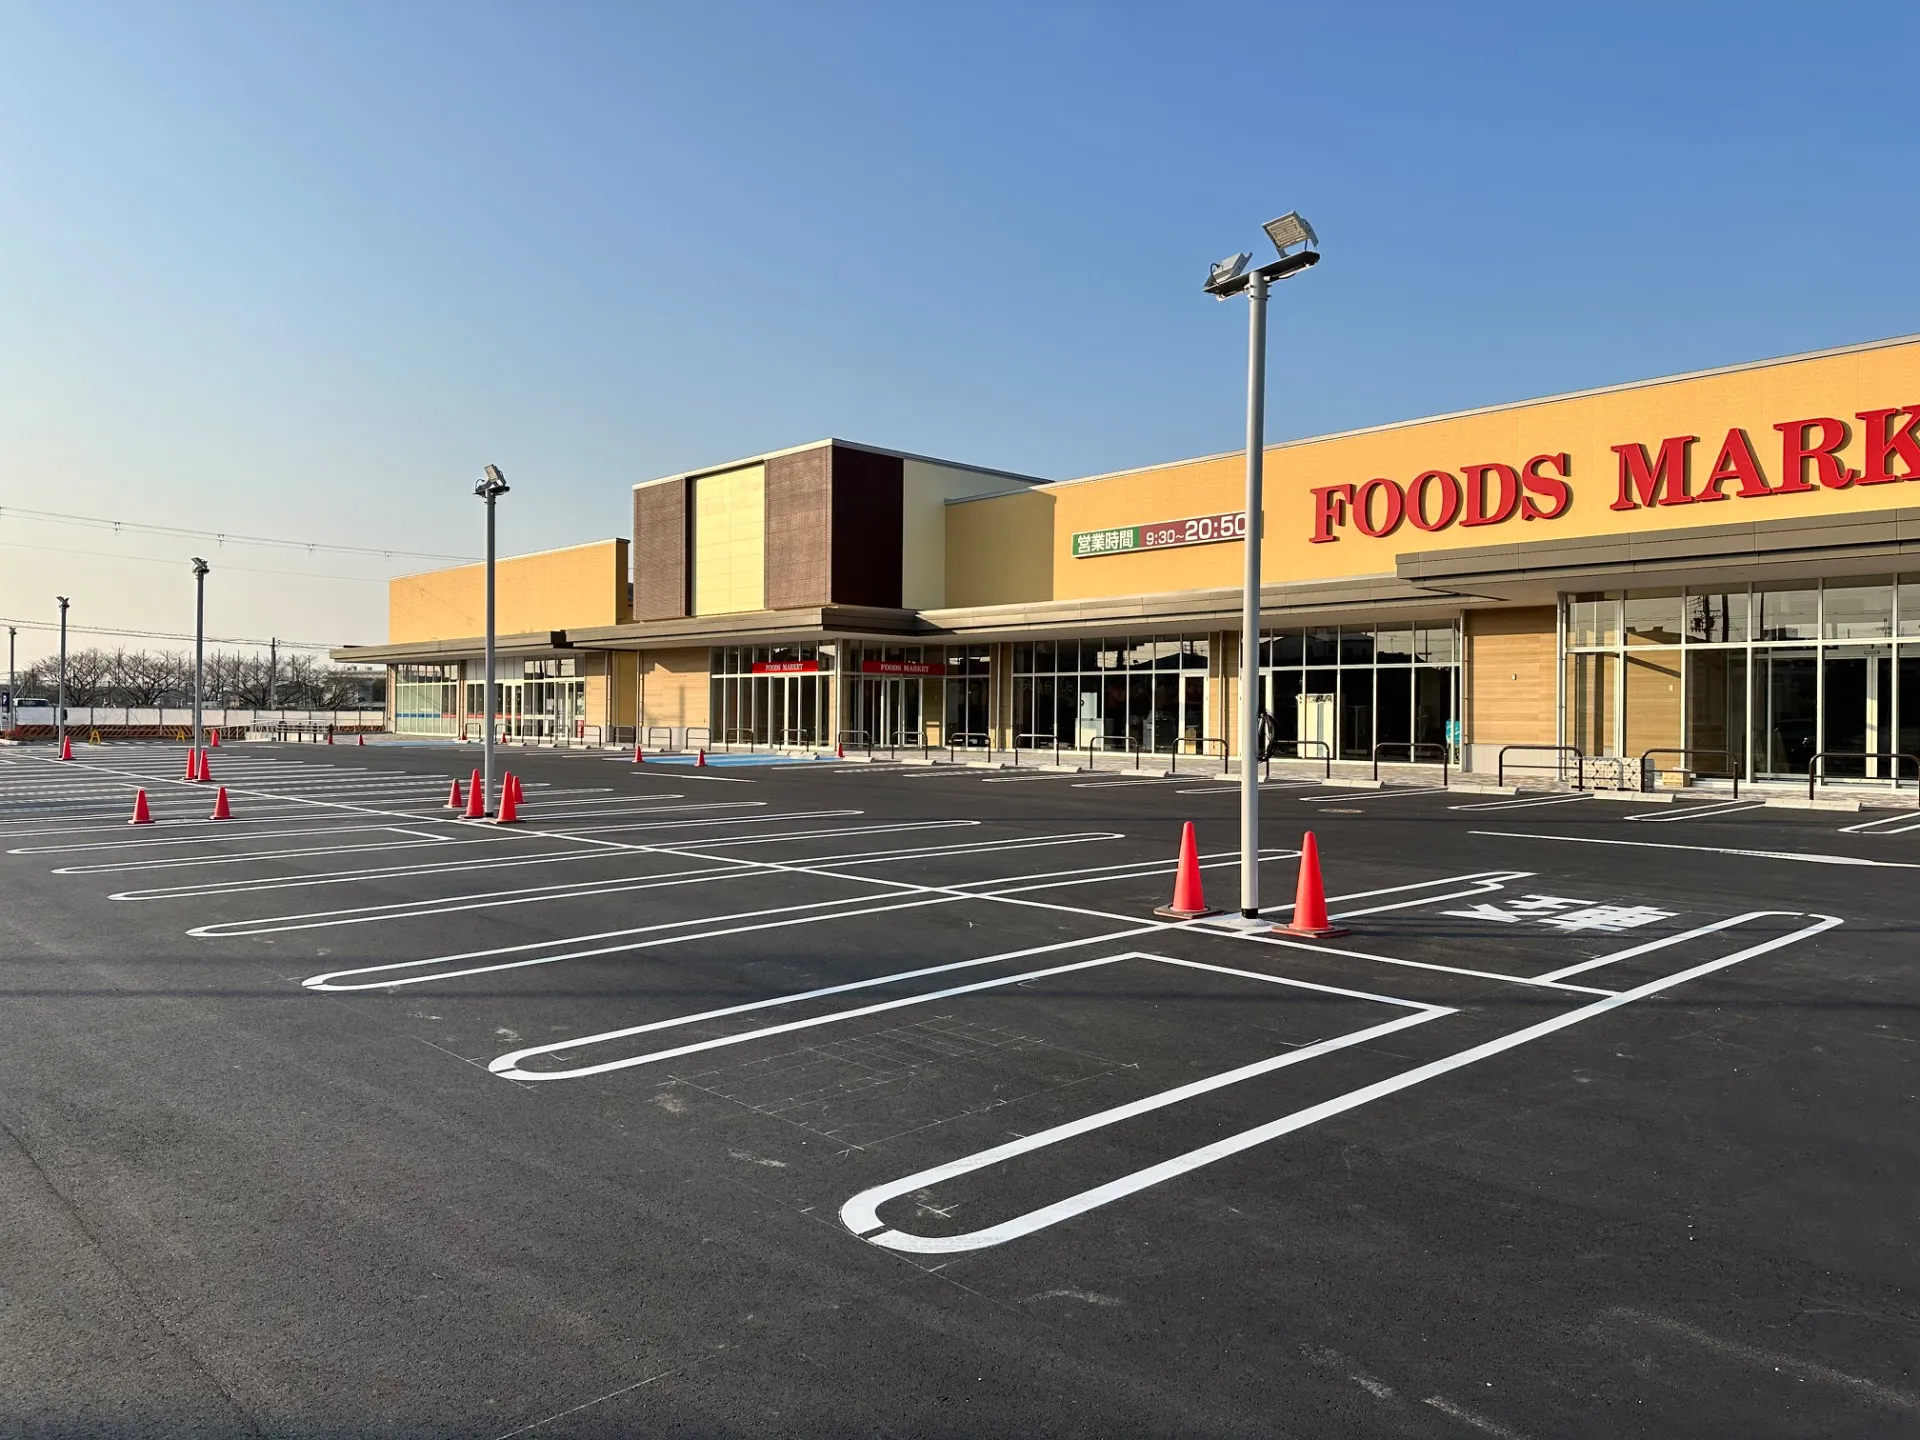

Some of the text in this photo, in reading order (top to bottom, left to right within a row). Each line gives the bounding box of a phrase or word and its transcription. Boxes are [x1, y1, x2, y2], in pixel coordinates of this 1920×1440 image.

[1309, 404, 1920, 544] FOODS MARK
[1077, 529, 1133, 553] 営業時間
[782, 663, 803, 671] MARKET
[903, 664, 929, 672] MARKET
[1439, 894, 1681, 932] 軽
